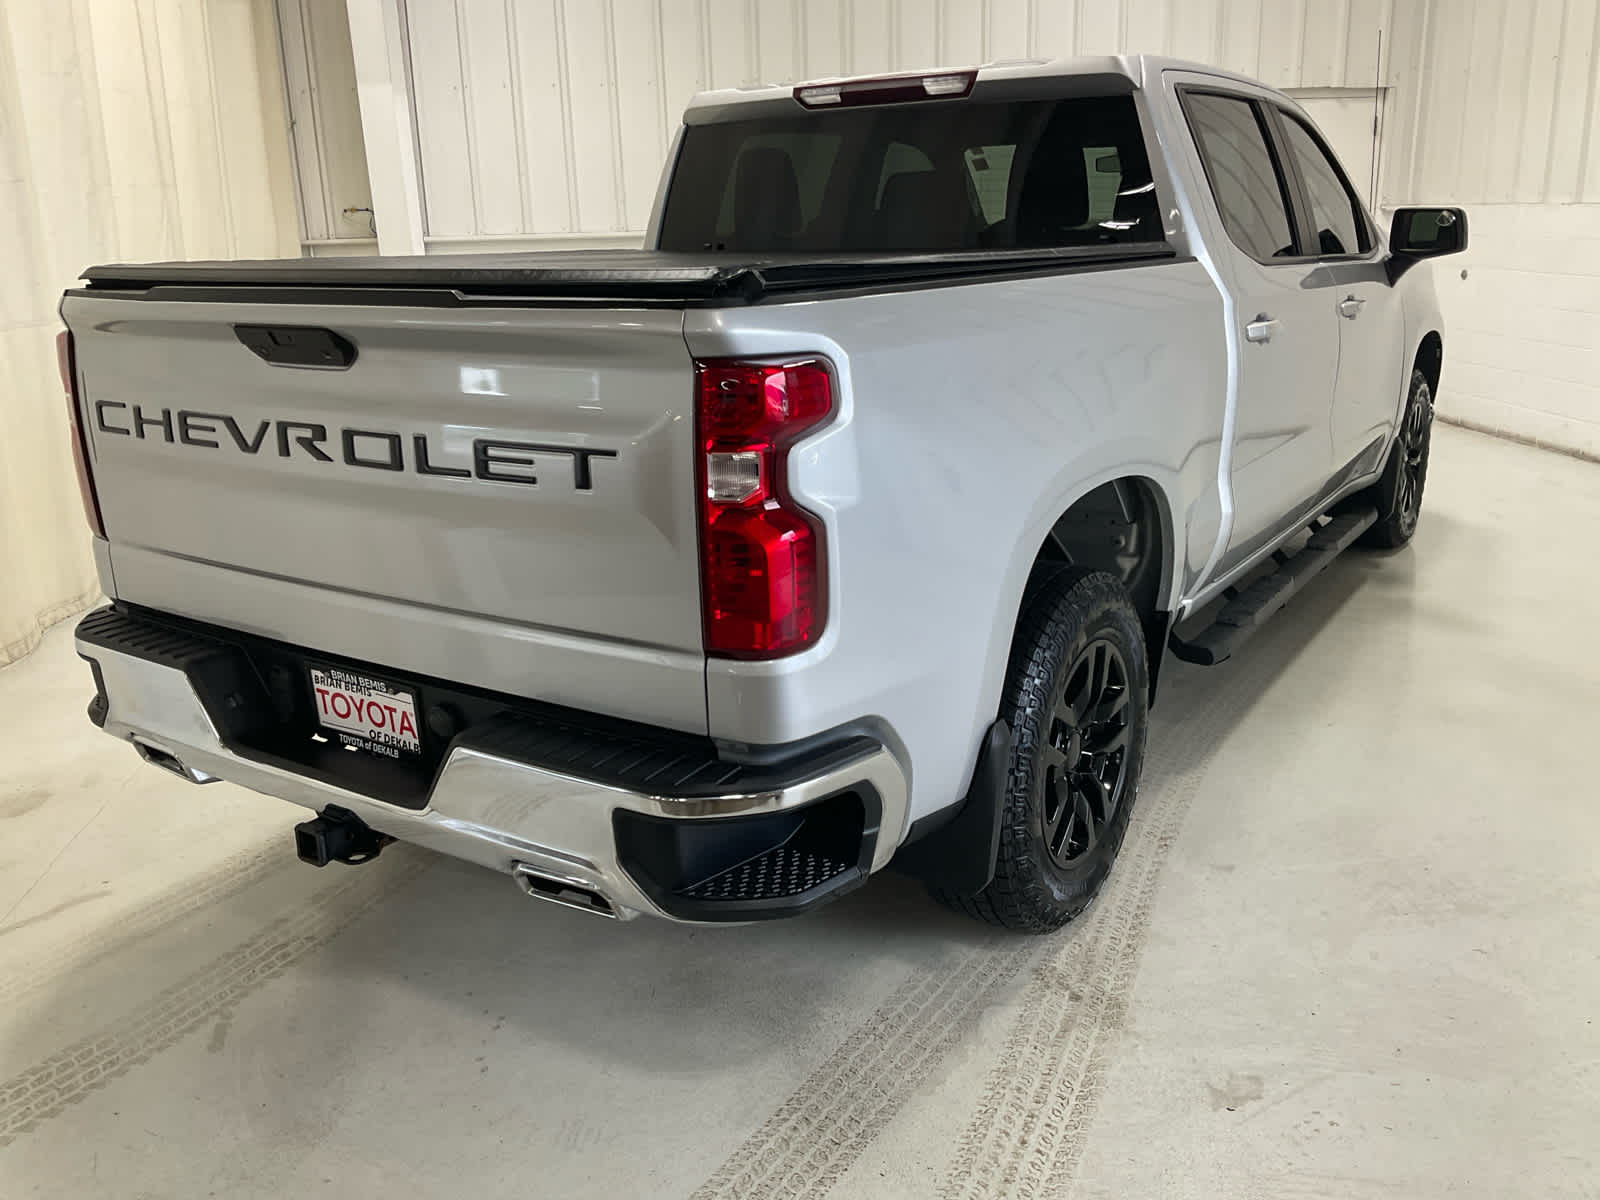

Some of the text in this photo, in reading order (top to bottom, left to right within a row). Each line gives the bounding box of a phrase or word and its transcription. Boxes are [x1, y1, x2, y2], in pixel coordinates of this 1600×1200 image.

[95, 399, 618, 490] CHEVROLET
[314, 674, 372, 697] BRIAN BEMIS
[331, 670, 386, 692] BRIAN BEMIS
[316, 687, 417, 739] TOYOTA
[338, 733, 399, 759] TOYOTA of DEKALB
[369, 729, 421, 754] OF DEKALB
